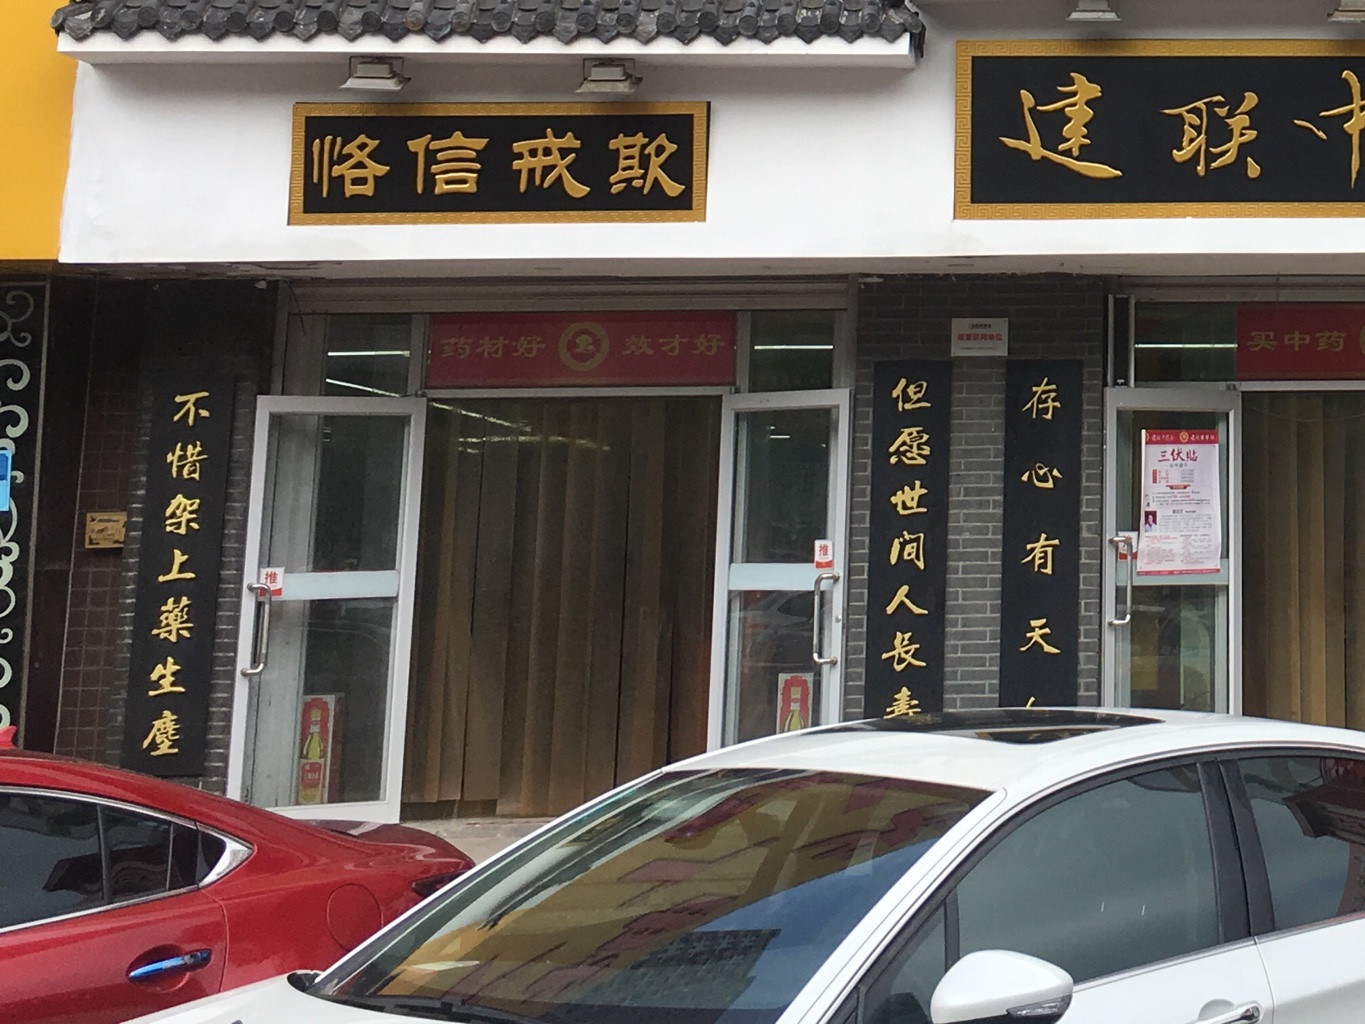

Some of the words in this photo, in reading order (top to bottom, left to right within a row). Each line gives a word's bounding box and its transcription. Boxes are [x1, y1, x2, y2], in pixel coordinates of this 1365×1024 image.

[311, 128, 686, 198] 恪信戒欺
[440, 335, 546, 358] 药材好
[1246, 331, 1348, 352] 买中药
[1018, 376, 1063, 710] 存心有天
